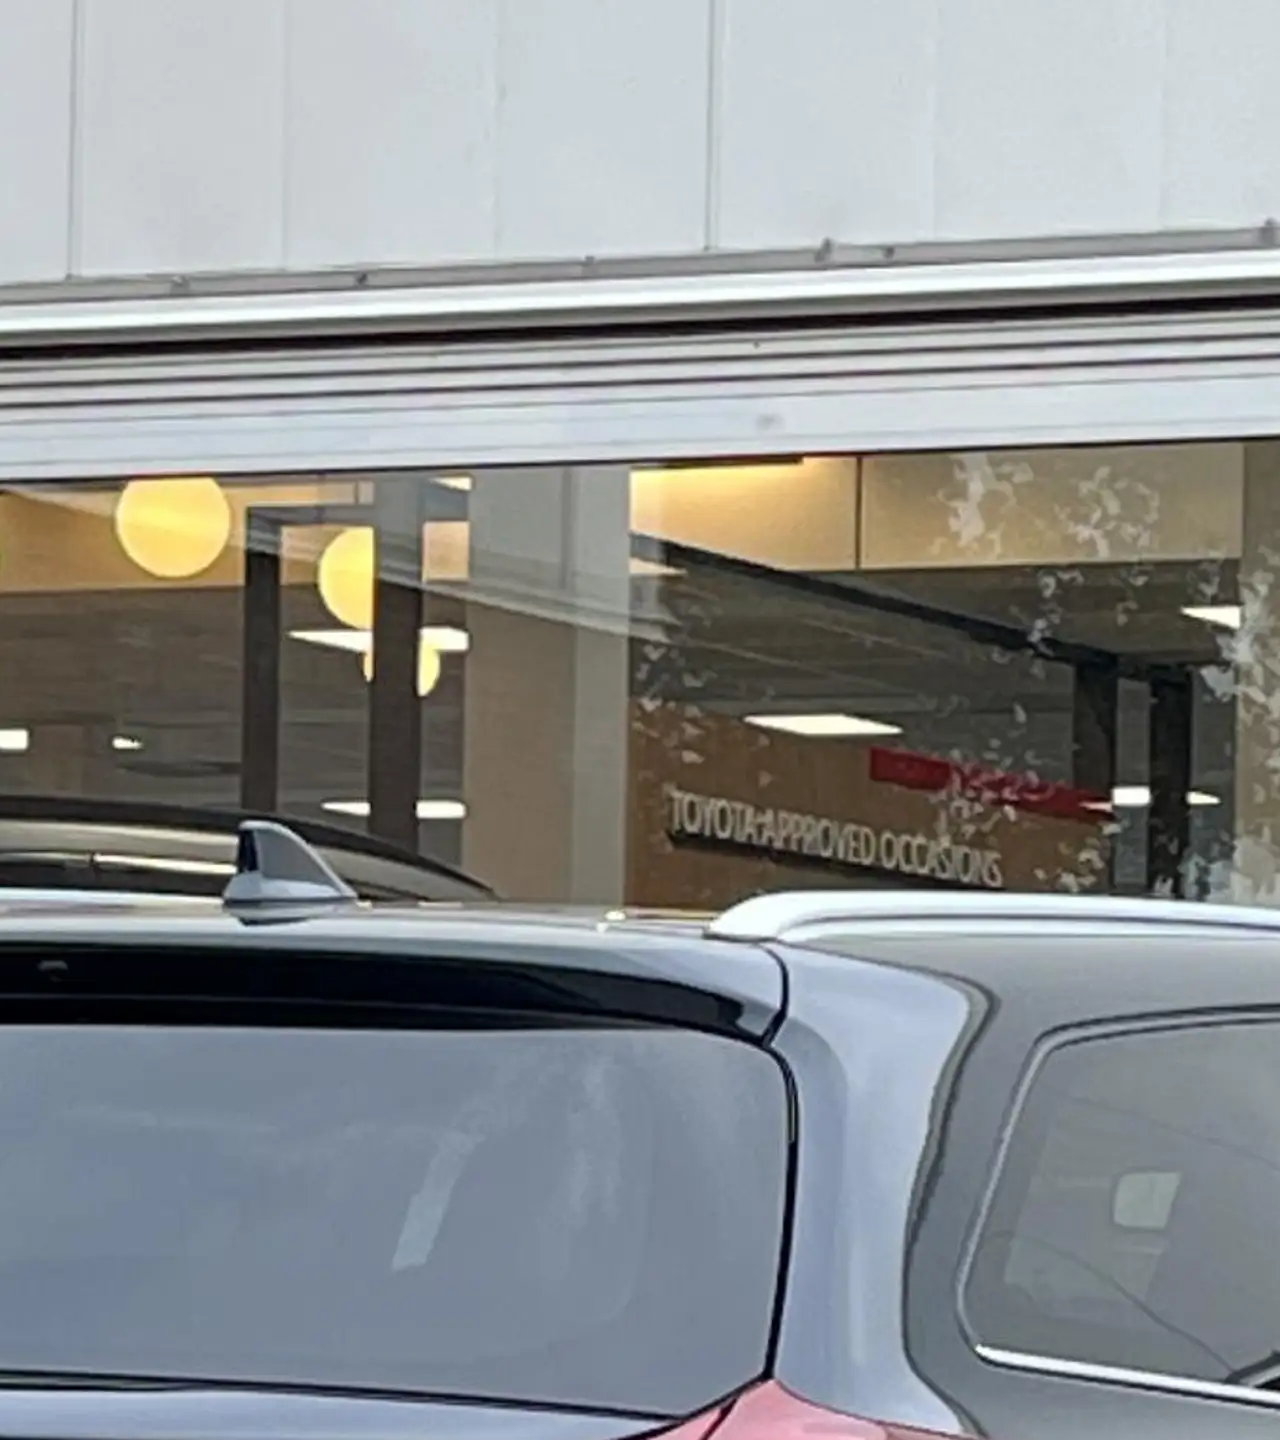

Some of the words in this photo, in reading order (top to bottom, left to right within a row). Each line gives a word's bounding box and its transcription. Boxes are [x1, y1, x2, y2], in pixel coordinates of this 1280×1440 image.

[668, 789, 756, 844] TOYOTA
[760, 806, 876, 866] APPROVED
[879, 829, 1003, 888] OCCASIONS
